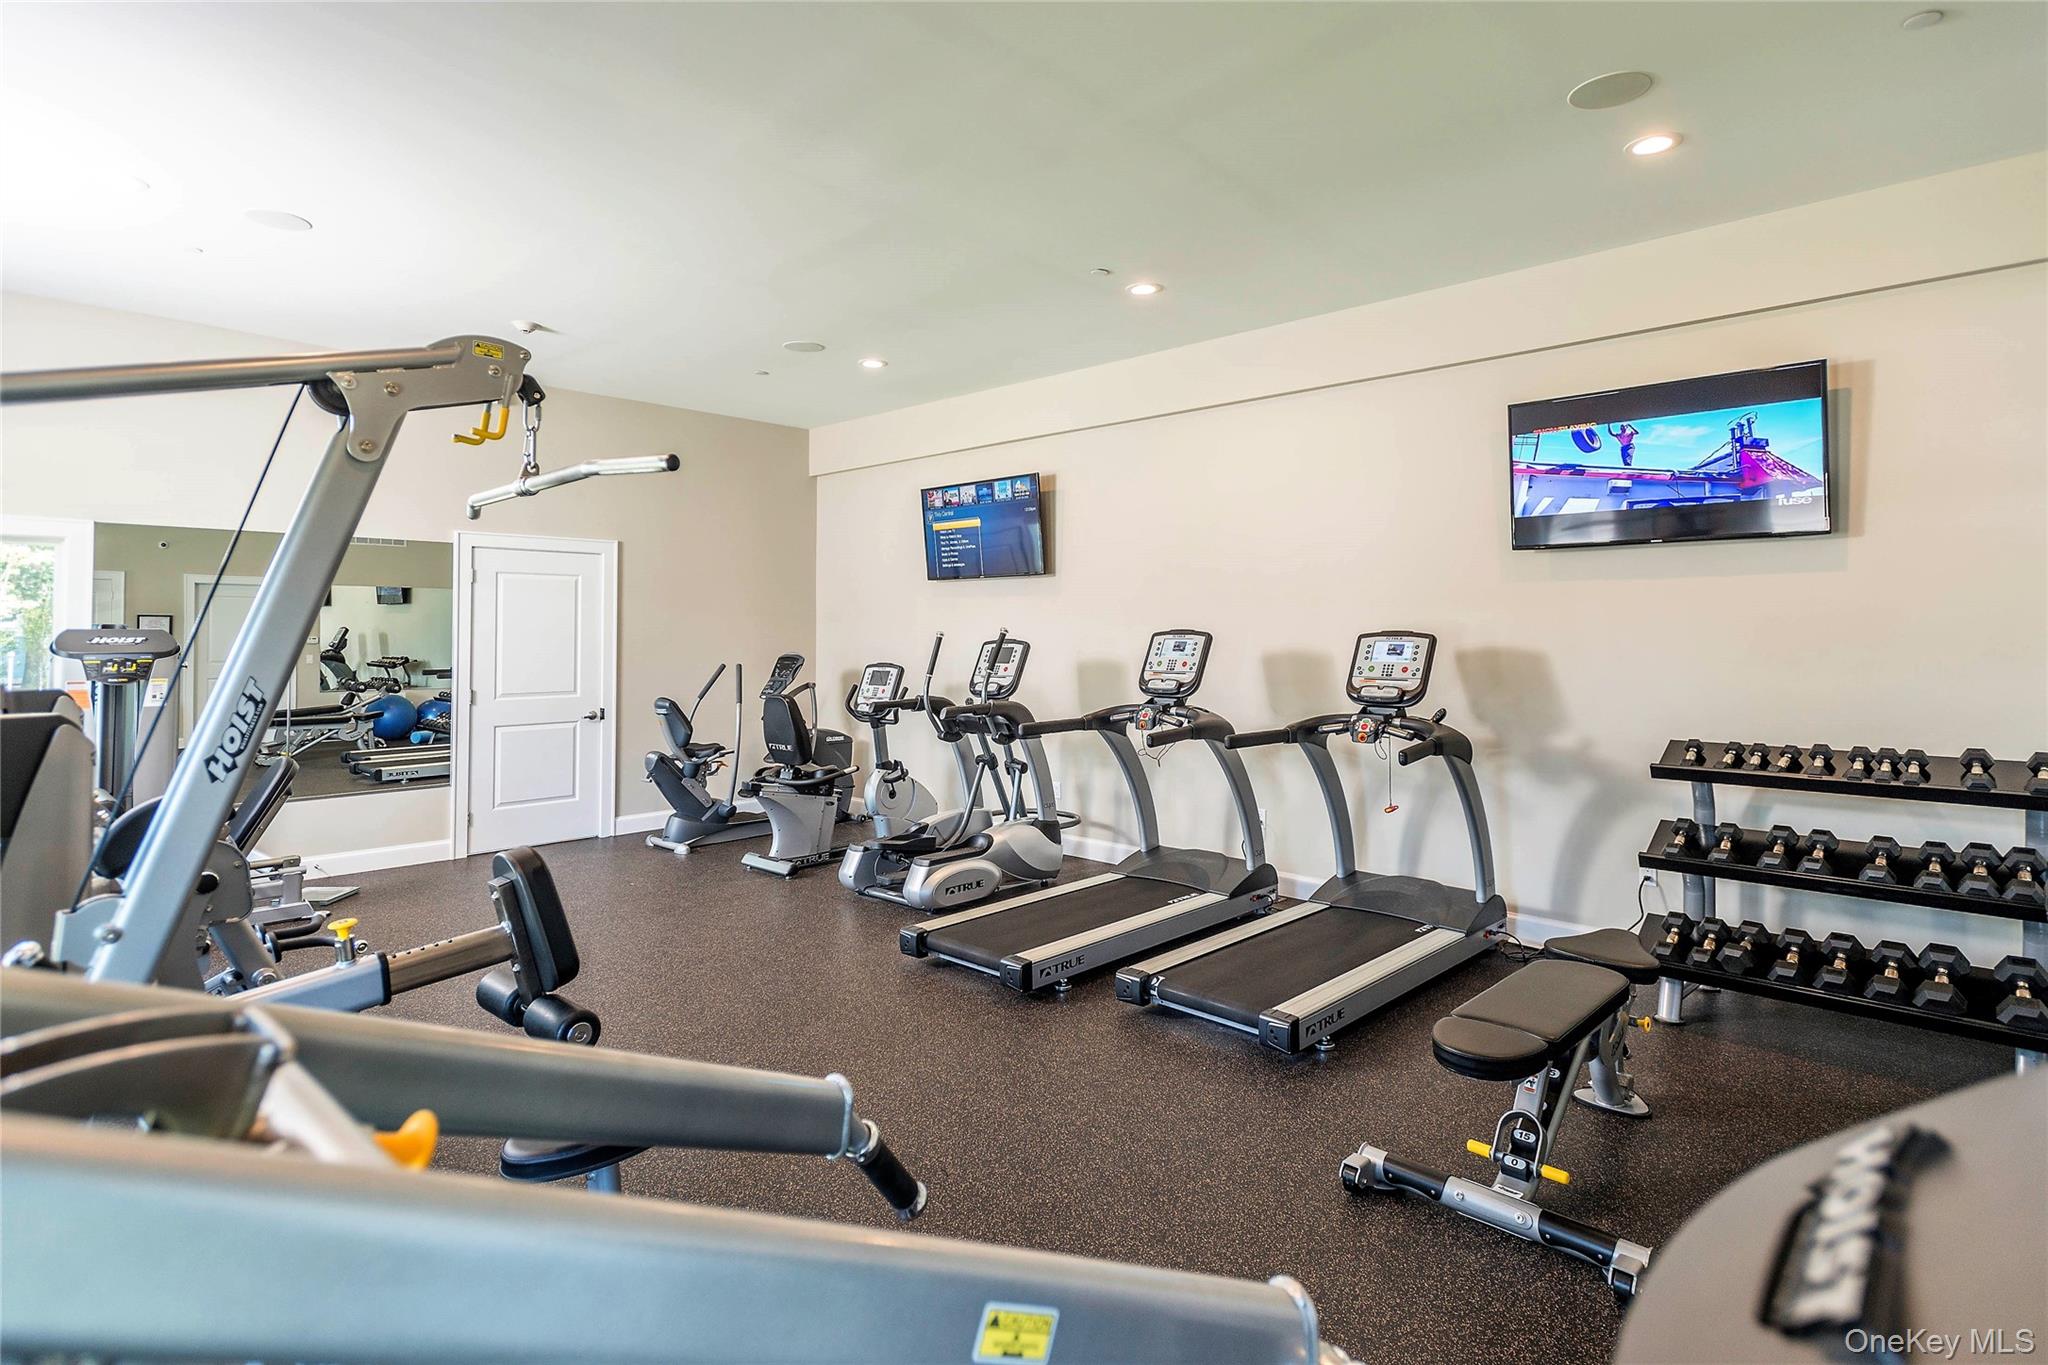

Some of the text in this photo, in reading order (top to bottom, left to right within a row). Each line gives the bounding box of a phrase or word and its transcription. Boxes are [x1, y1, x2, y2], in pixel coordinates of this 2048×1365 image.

[88, 636, 147, 645] HOIST
[207, 675, 265, 783] HOIST
[802, 852, 830, 865] TRUE
[957, 879, 985, 894] TRUE
[1053, 954, 1085, 974] TRUE
[1316, 1007, 1345, 1031] TRUE
[1519, 1131, 1532, 1142] 15
[1511, 1158, 1518, 1167] 0
